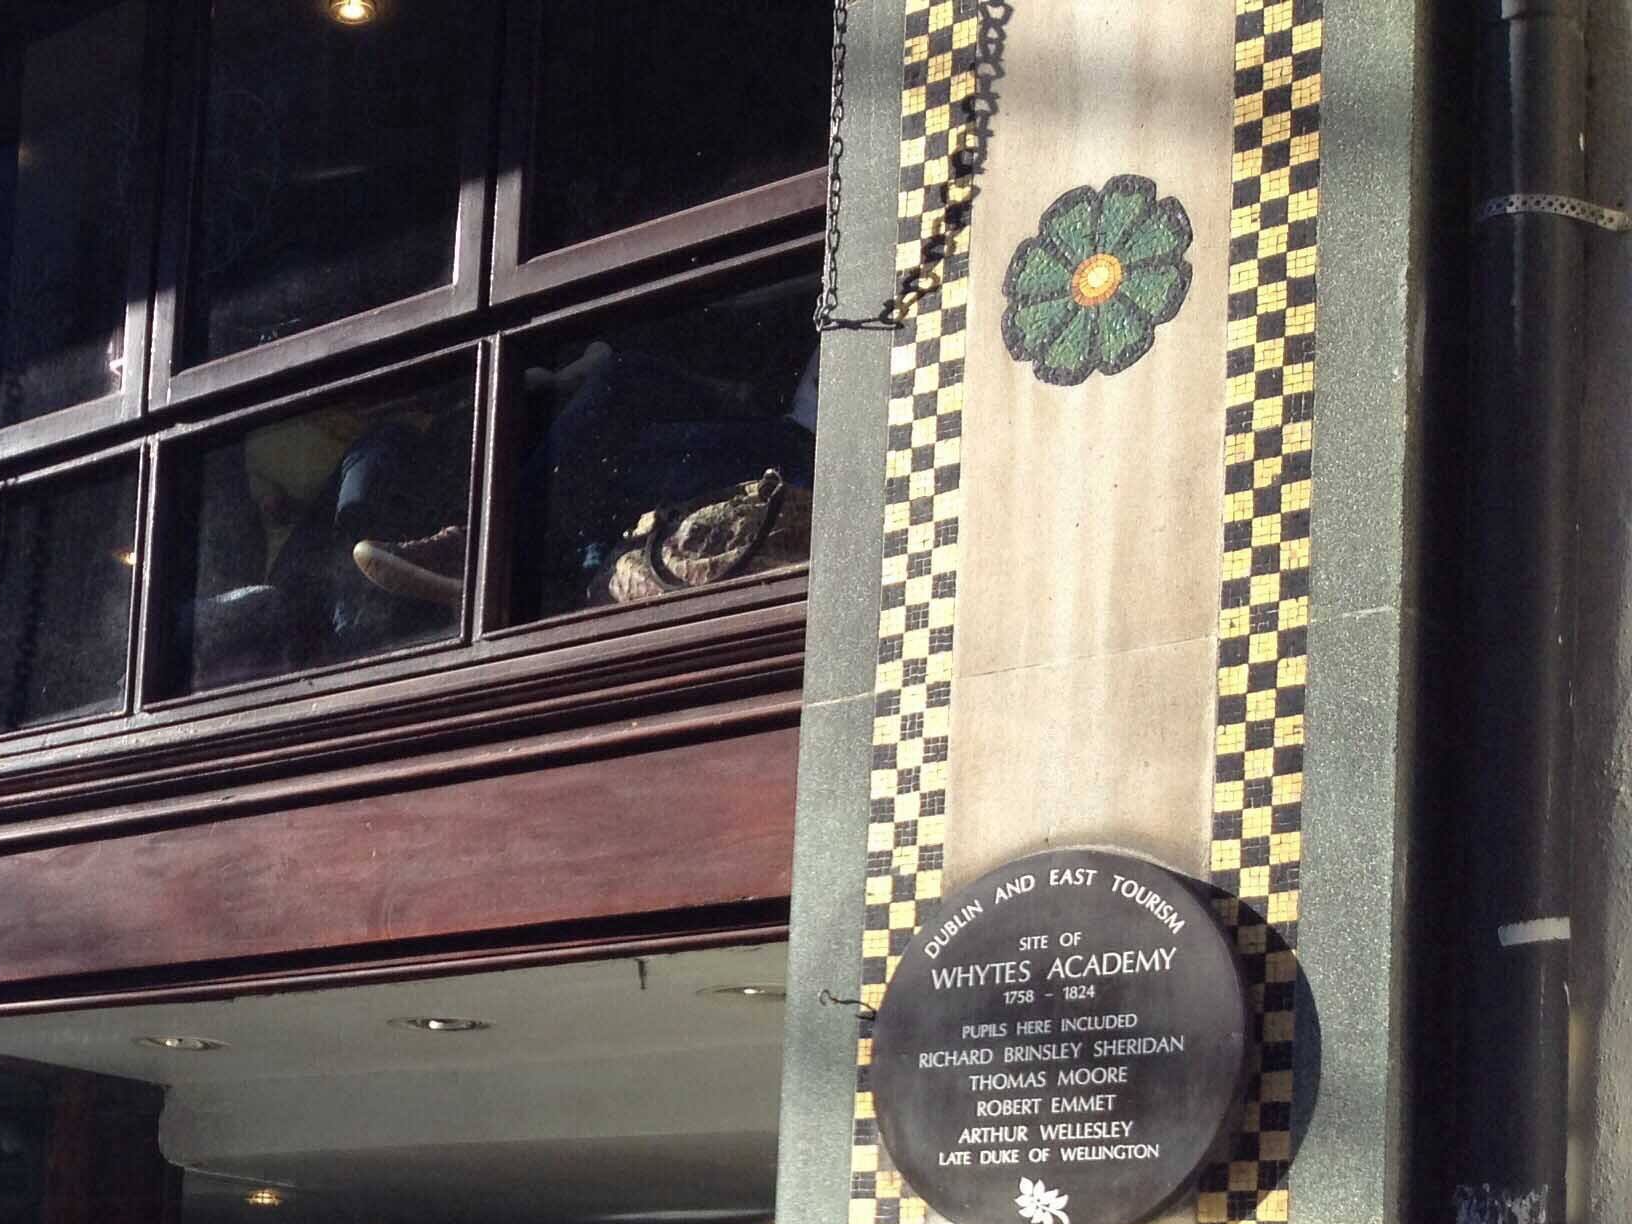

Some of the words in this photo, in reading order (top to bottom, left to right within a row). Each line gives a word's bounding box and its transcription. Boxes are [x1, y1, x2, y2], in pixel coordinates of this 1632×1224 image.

[924, 900, 984, 959] DUBLIN
[995, 875, 1035, 904] AND
[1050, 869, 1097, 887] EAST
[1111, 875, 1185, 935] TOURISM
[1019, 934, 1049, 951] SITE
[1059, 932, 1082, 948] OF
[932, 960, 1031, 990] WHYTES
[1047, 946, 1176, 980] ACADEMY
[1003, 989, 1035, 1005] 1758
[1062, 984, 1096, 1000] 1824
[962, 1022, 1007, 1039] PUPILS
[1017, 1019, 1052, 1035] HERE
[1061, 1013, 1138, 1032] INCLUDED
[919, 1049, 993, 1068] RICHARD
[1004, 1042, 1082, 1063] BRINSLEY
[1093, 1035, 1185, 1057] SHERIDAN
[969, 1071, 1046, 1091] THOMAS
[1057, 1066, 1128, 1085] MOORE
[976, 1098, 1043, 1117] ROBERT
[1051, 1094, 1117, 1113] EMMET
[958, 1126, 1028, 1144] ARTHUR
[1040, 1120, 1133, 1140] WELLESLEY
[939, 1152, 972, 1166] LATE
[980, 1150, 1019, 1164] DUKE
[1028, 1148, 1050, 1163] OF
[1060, 1143, 1160, 1161] WELLINGTON
